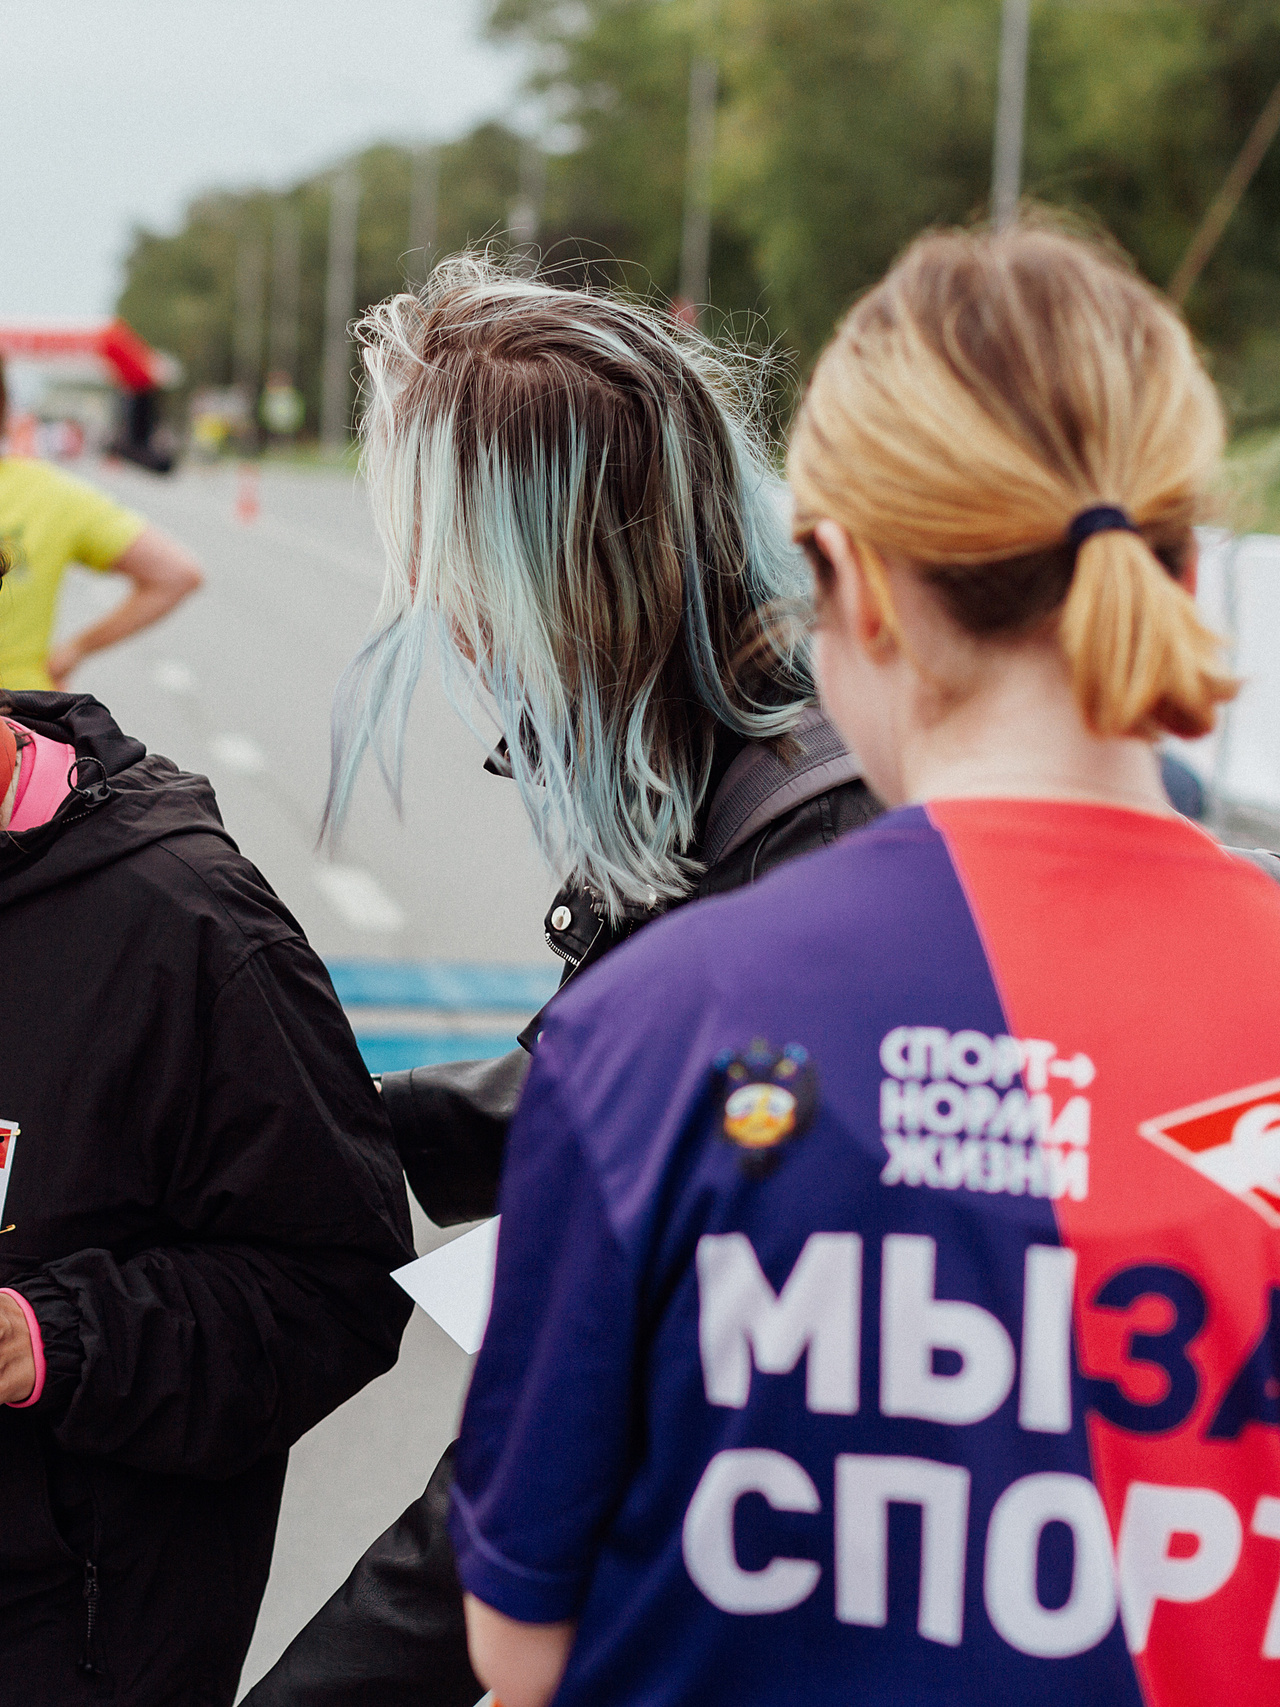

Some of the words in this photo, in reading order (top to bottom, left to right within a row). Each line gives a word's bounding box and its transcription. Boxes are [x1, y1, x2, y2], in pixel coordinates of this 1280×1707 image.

[879, 1026, 1058, 1091] СПОРТ
[879, 1077, 1092, 1147] НОРМА
[879, 1133, 1090, 1202] ЖИЗНИ
[696, 1232, 1077, 1434] МЫ
